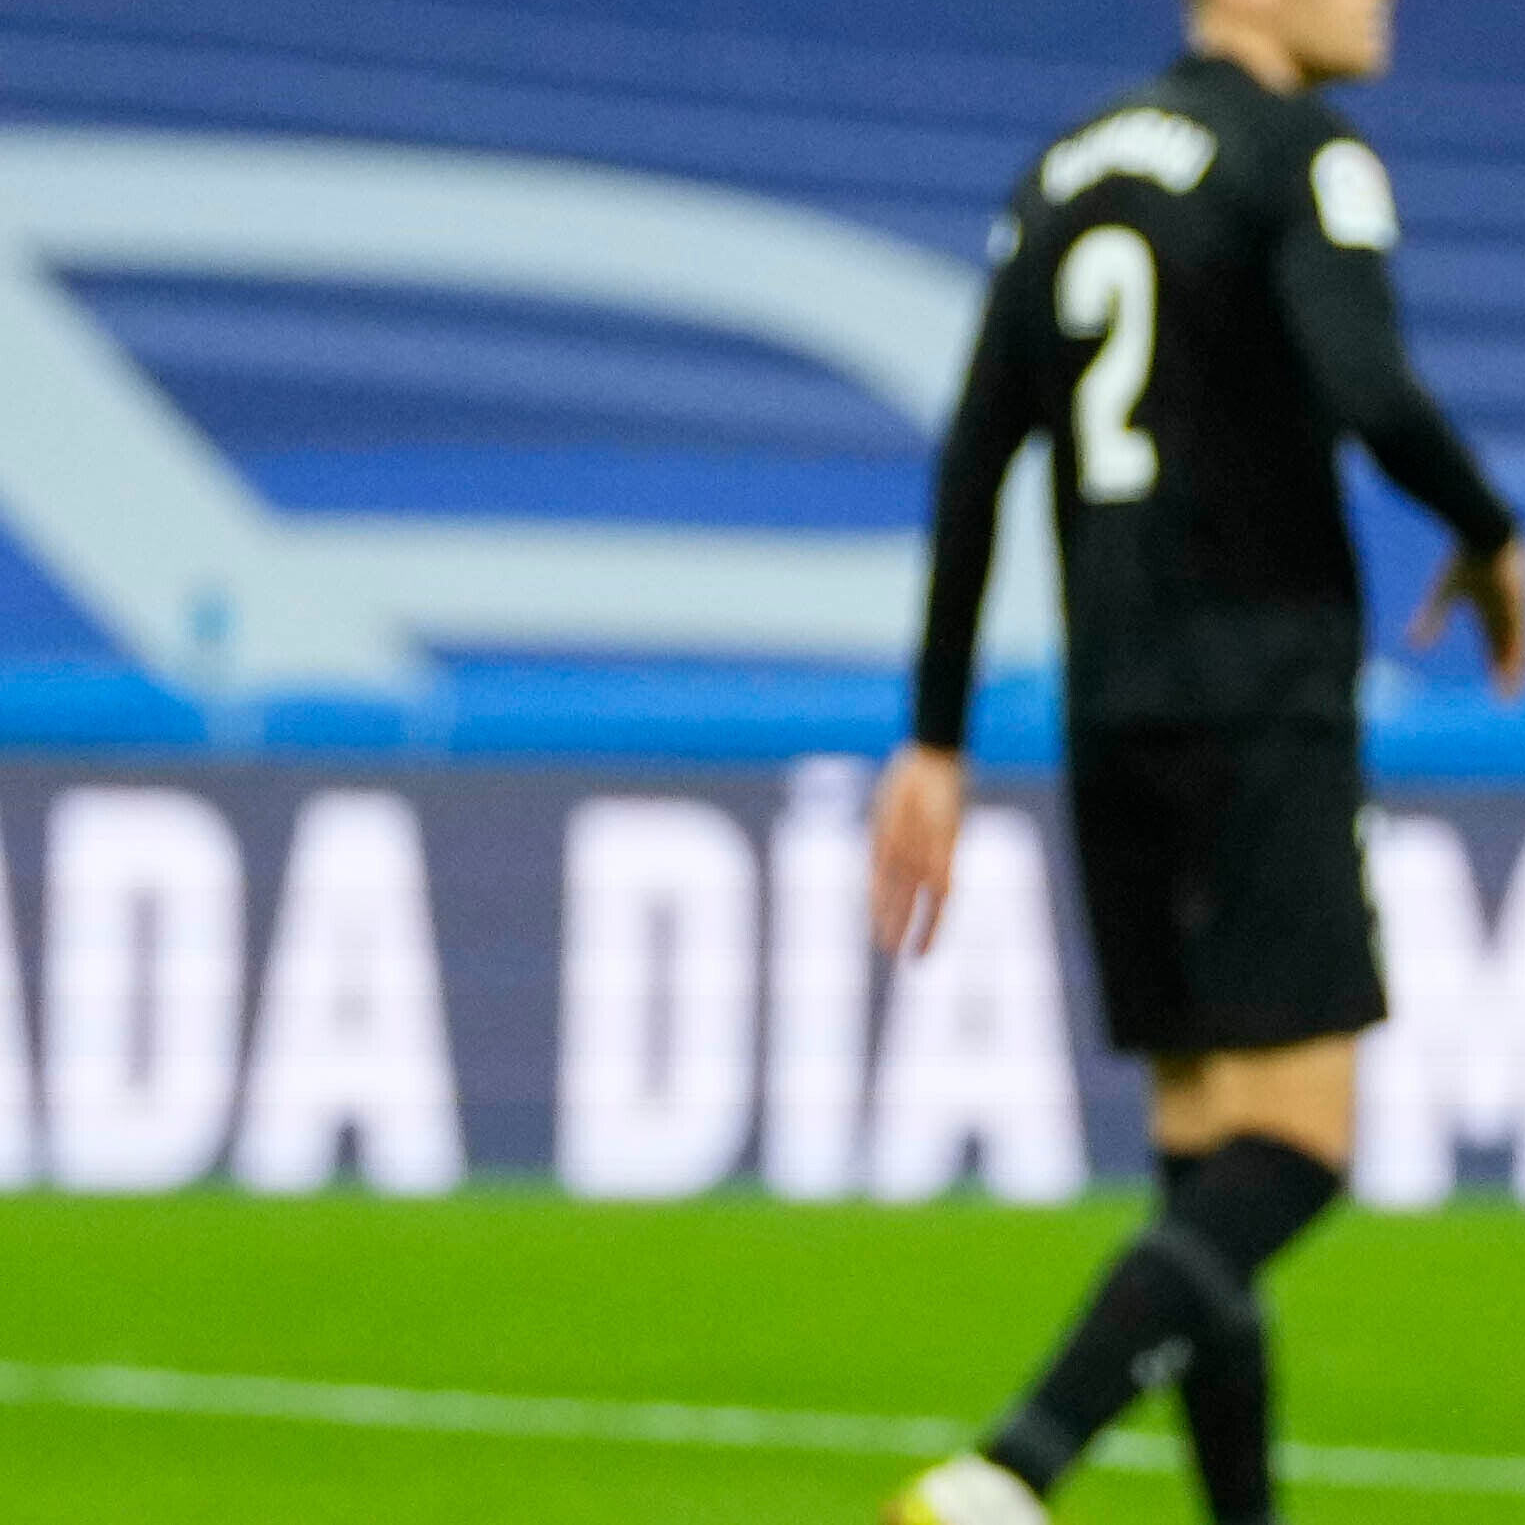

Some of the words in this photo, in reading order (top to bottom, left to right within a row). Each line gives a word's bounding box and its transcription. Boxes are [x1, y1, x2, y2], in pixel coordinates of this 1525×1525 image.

[1053, 223, 1159, 504] 2
[0, 787, 468, 1195] DA
[553, 753, 1090, 1205] DÍA
